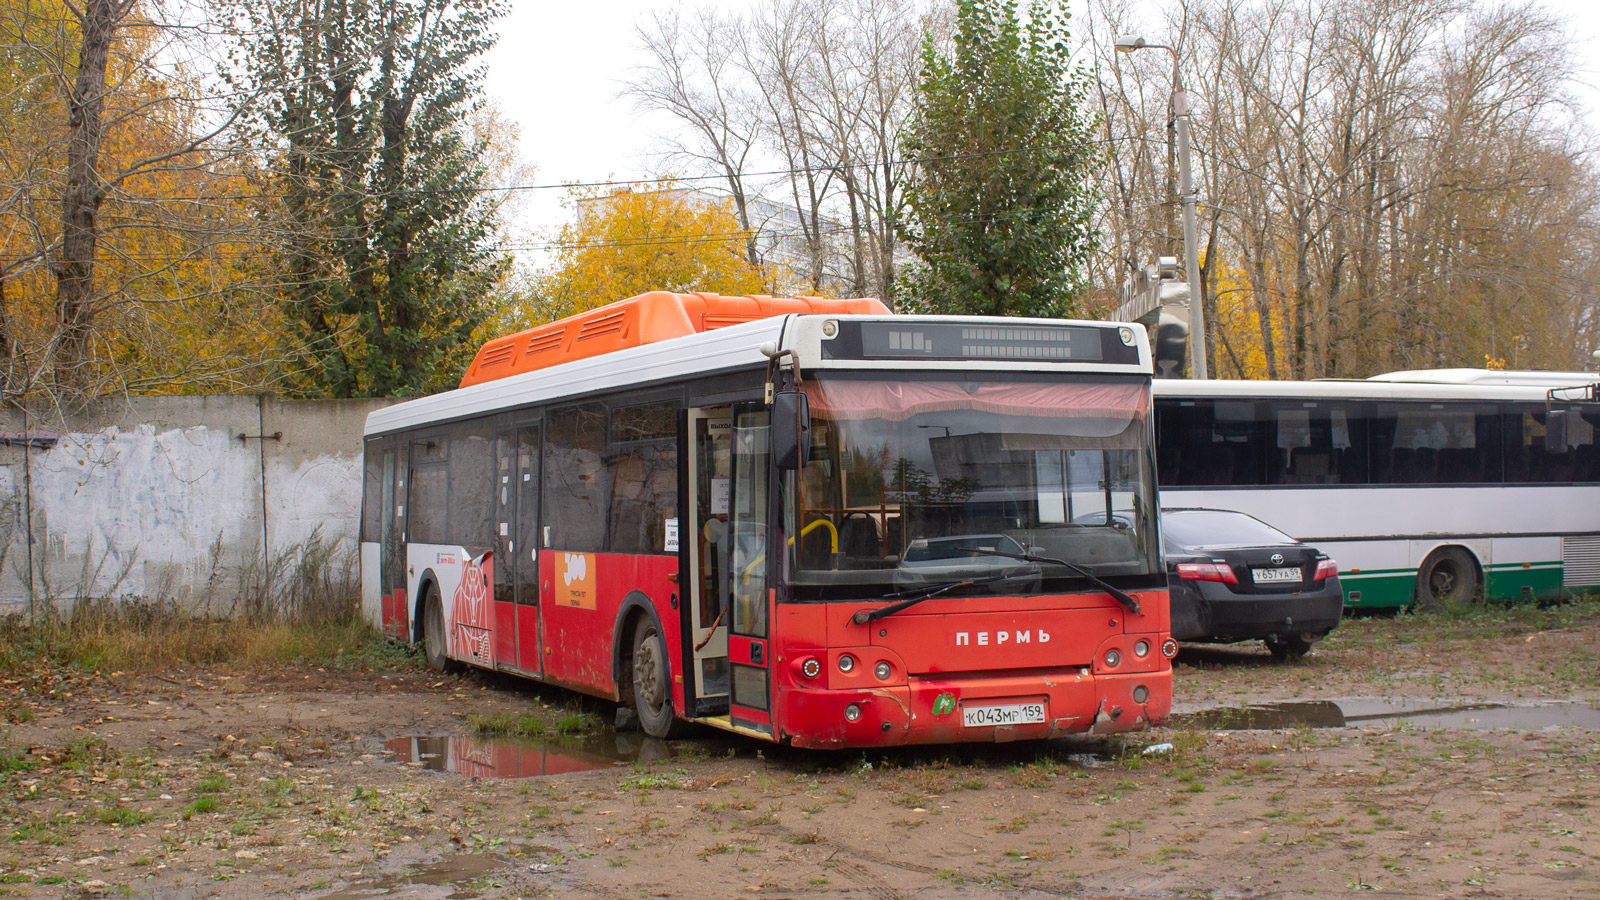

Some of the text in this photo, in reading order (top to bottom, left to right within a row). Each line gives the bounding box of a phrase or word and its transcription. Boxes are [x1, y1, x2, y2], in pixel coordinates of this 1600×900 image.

[956, 629, 1050, 646] ПЕРМЬ
[968, 705, 1041, 724] К043МР 159
